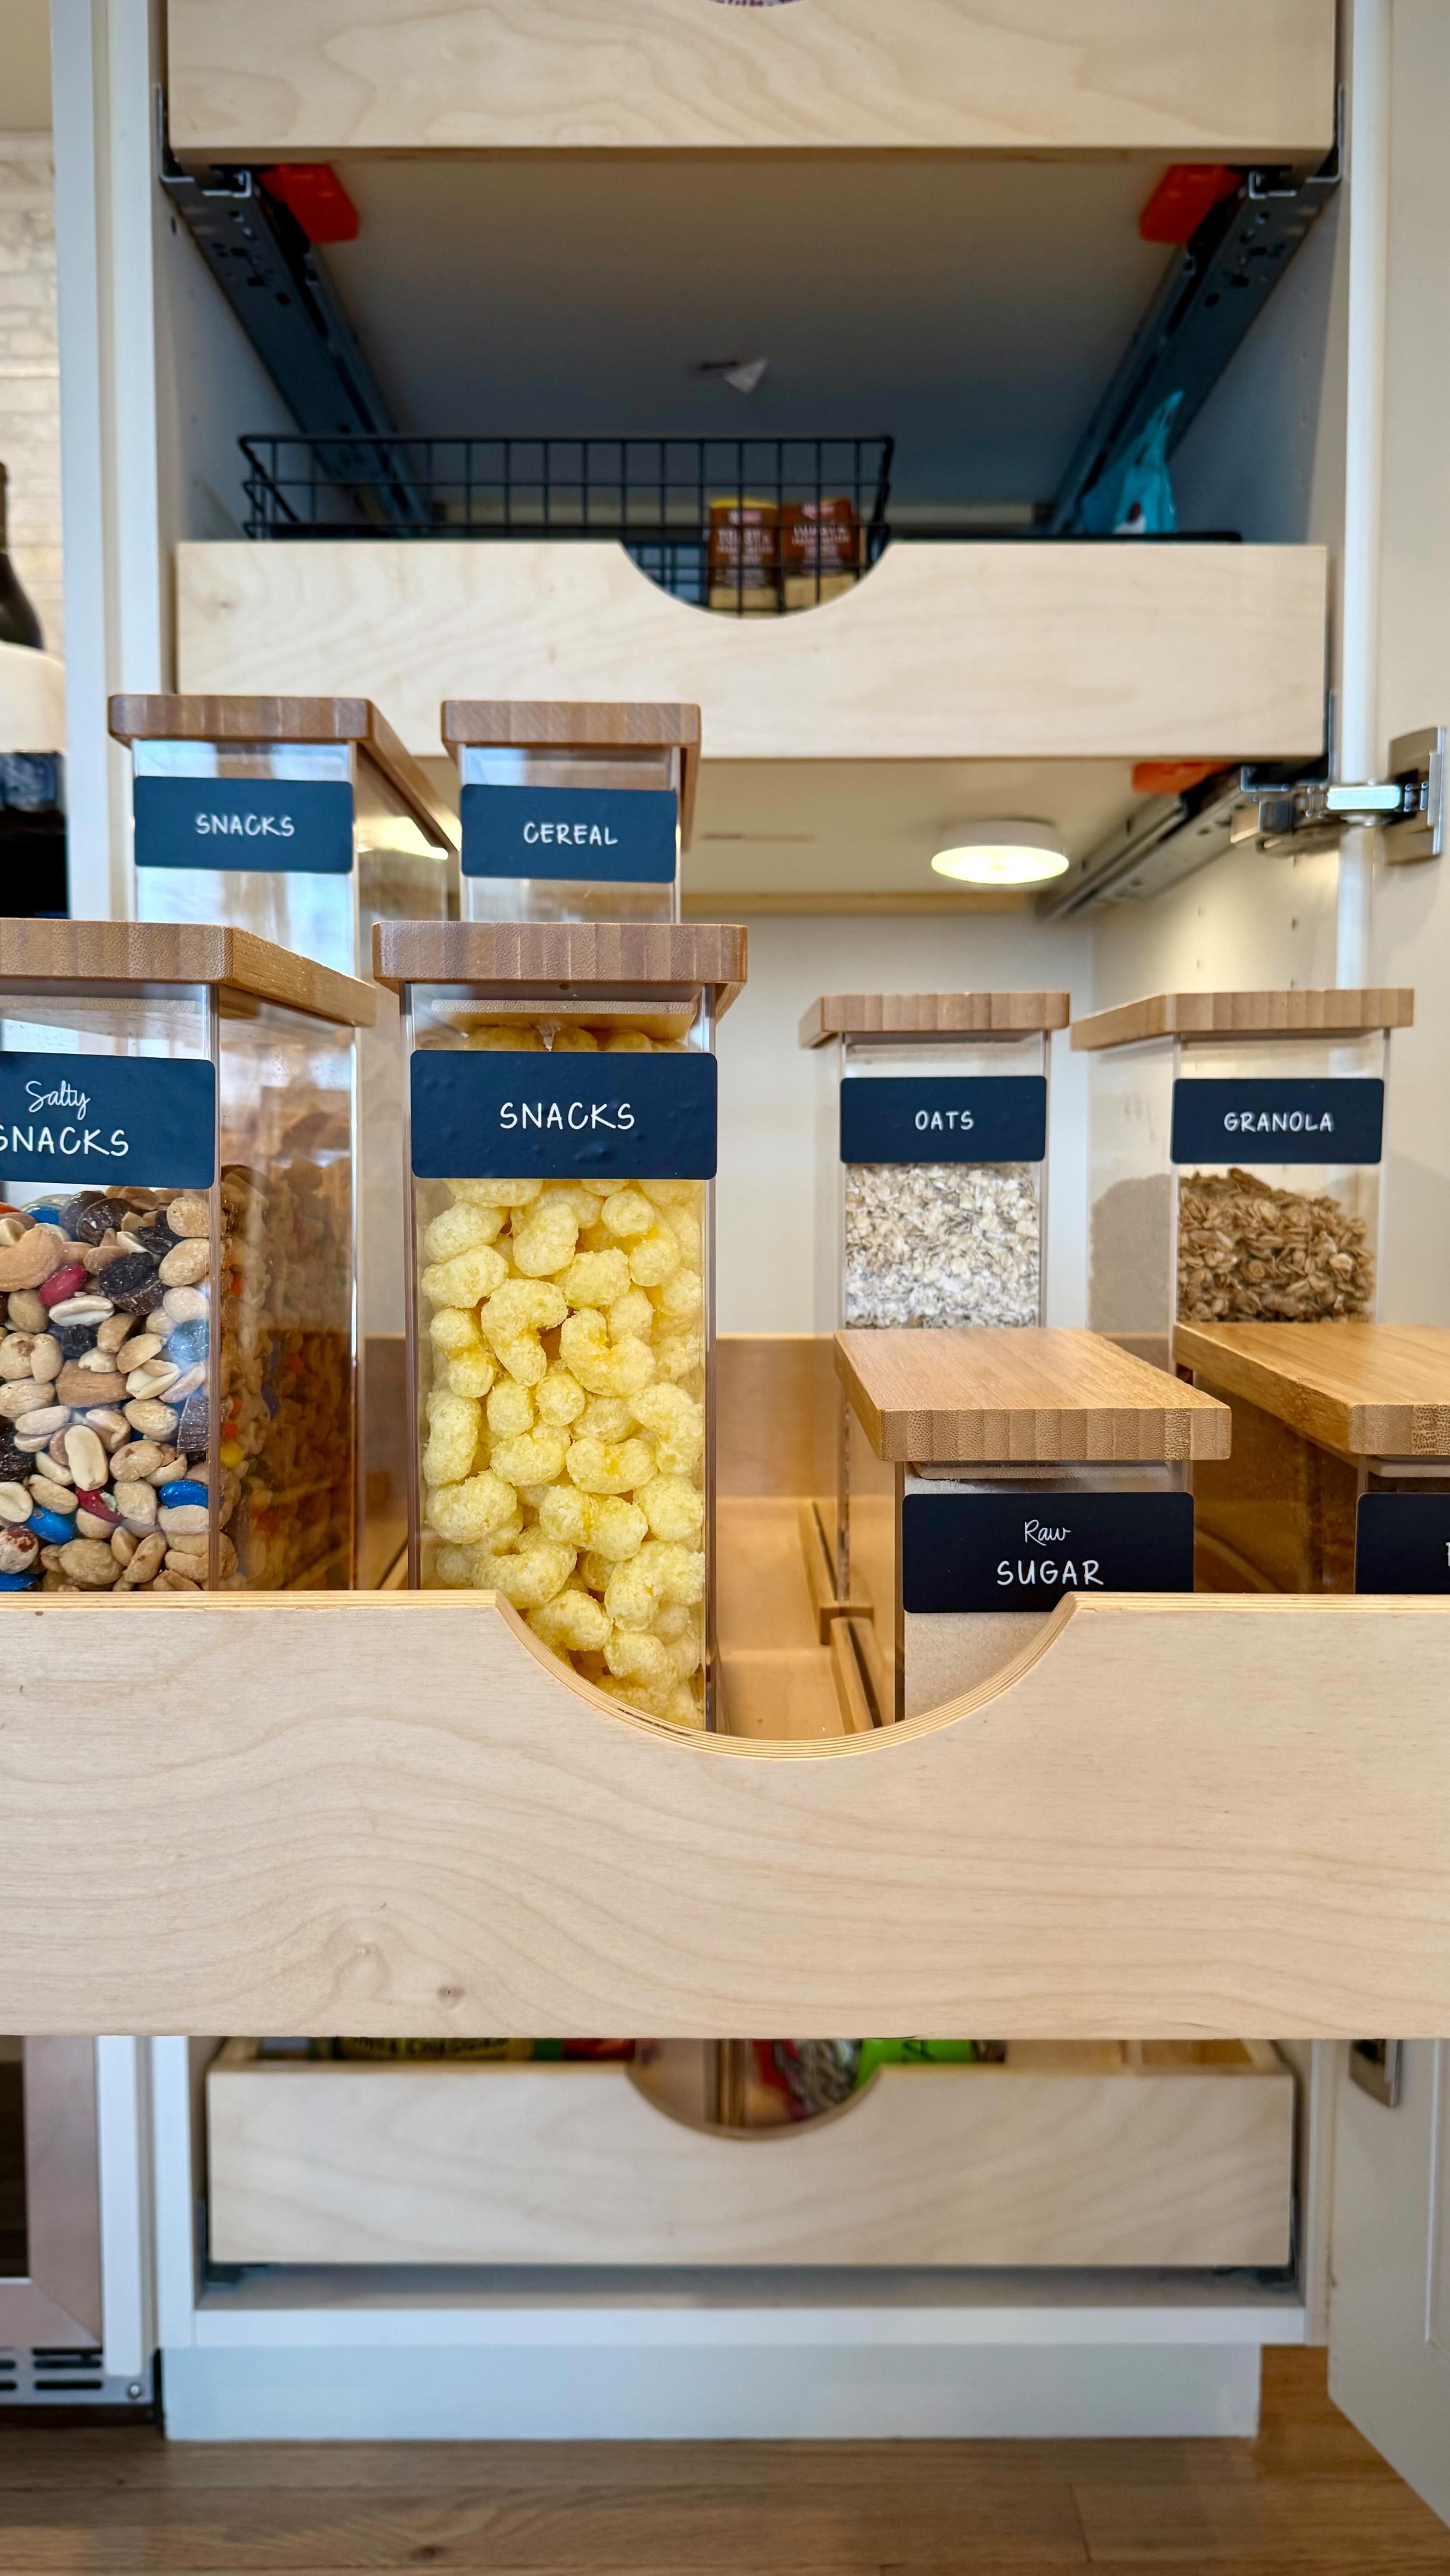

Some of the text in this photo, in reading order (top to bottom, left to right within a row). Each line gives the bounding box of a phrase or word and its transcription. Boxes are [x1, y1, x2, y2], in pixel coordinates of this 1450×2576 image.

[196, 814, 295, 838] SNACKS
[523, 822, 618, 846] CEREAL
[25, 1080, 91, 1121] Salty
[500, 1102, 635, 1130] SNACKS
[915, 1110, 974, 1131] OATS
[1224, 1111, 1334, 1132] GRANOLA
[1024, 1519, 1071, 1546] Raw
[997, 1560, 1104, 1586] SUGAR
